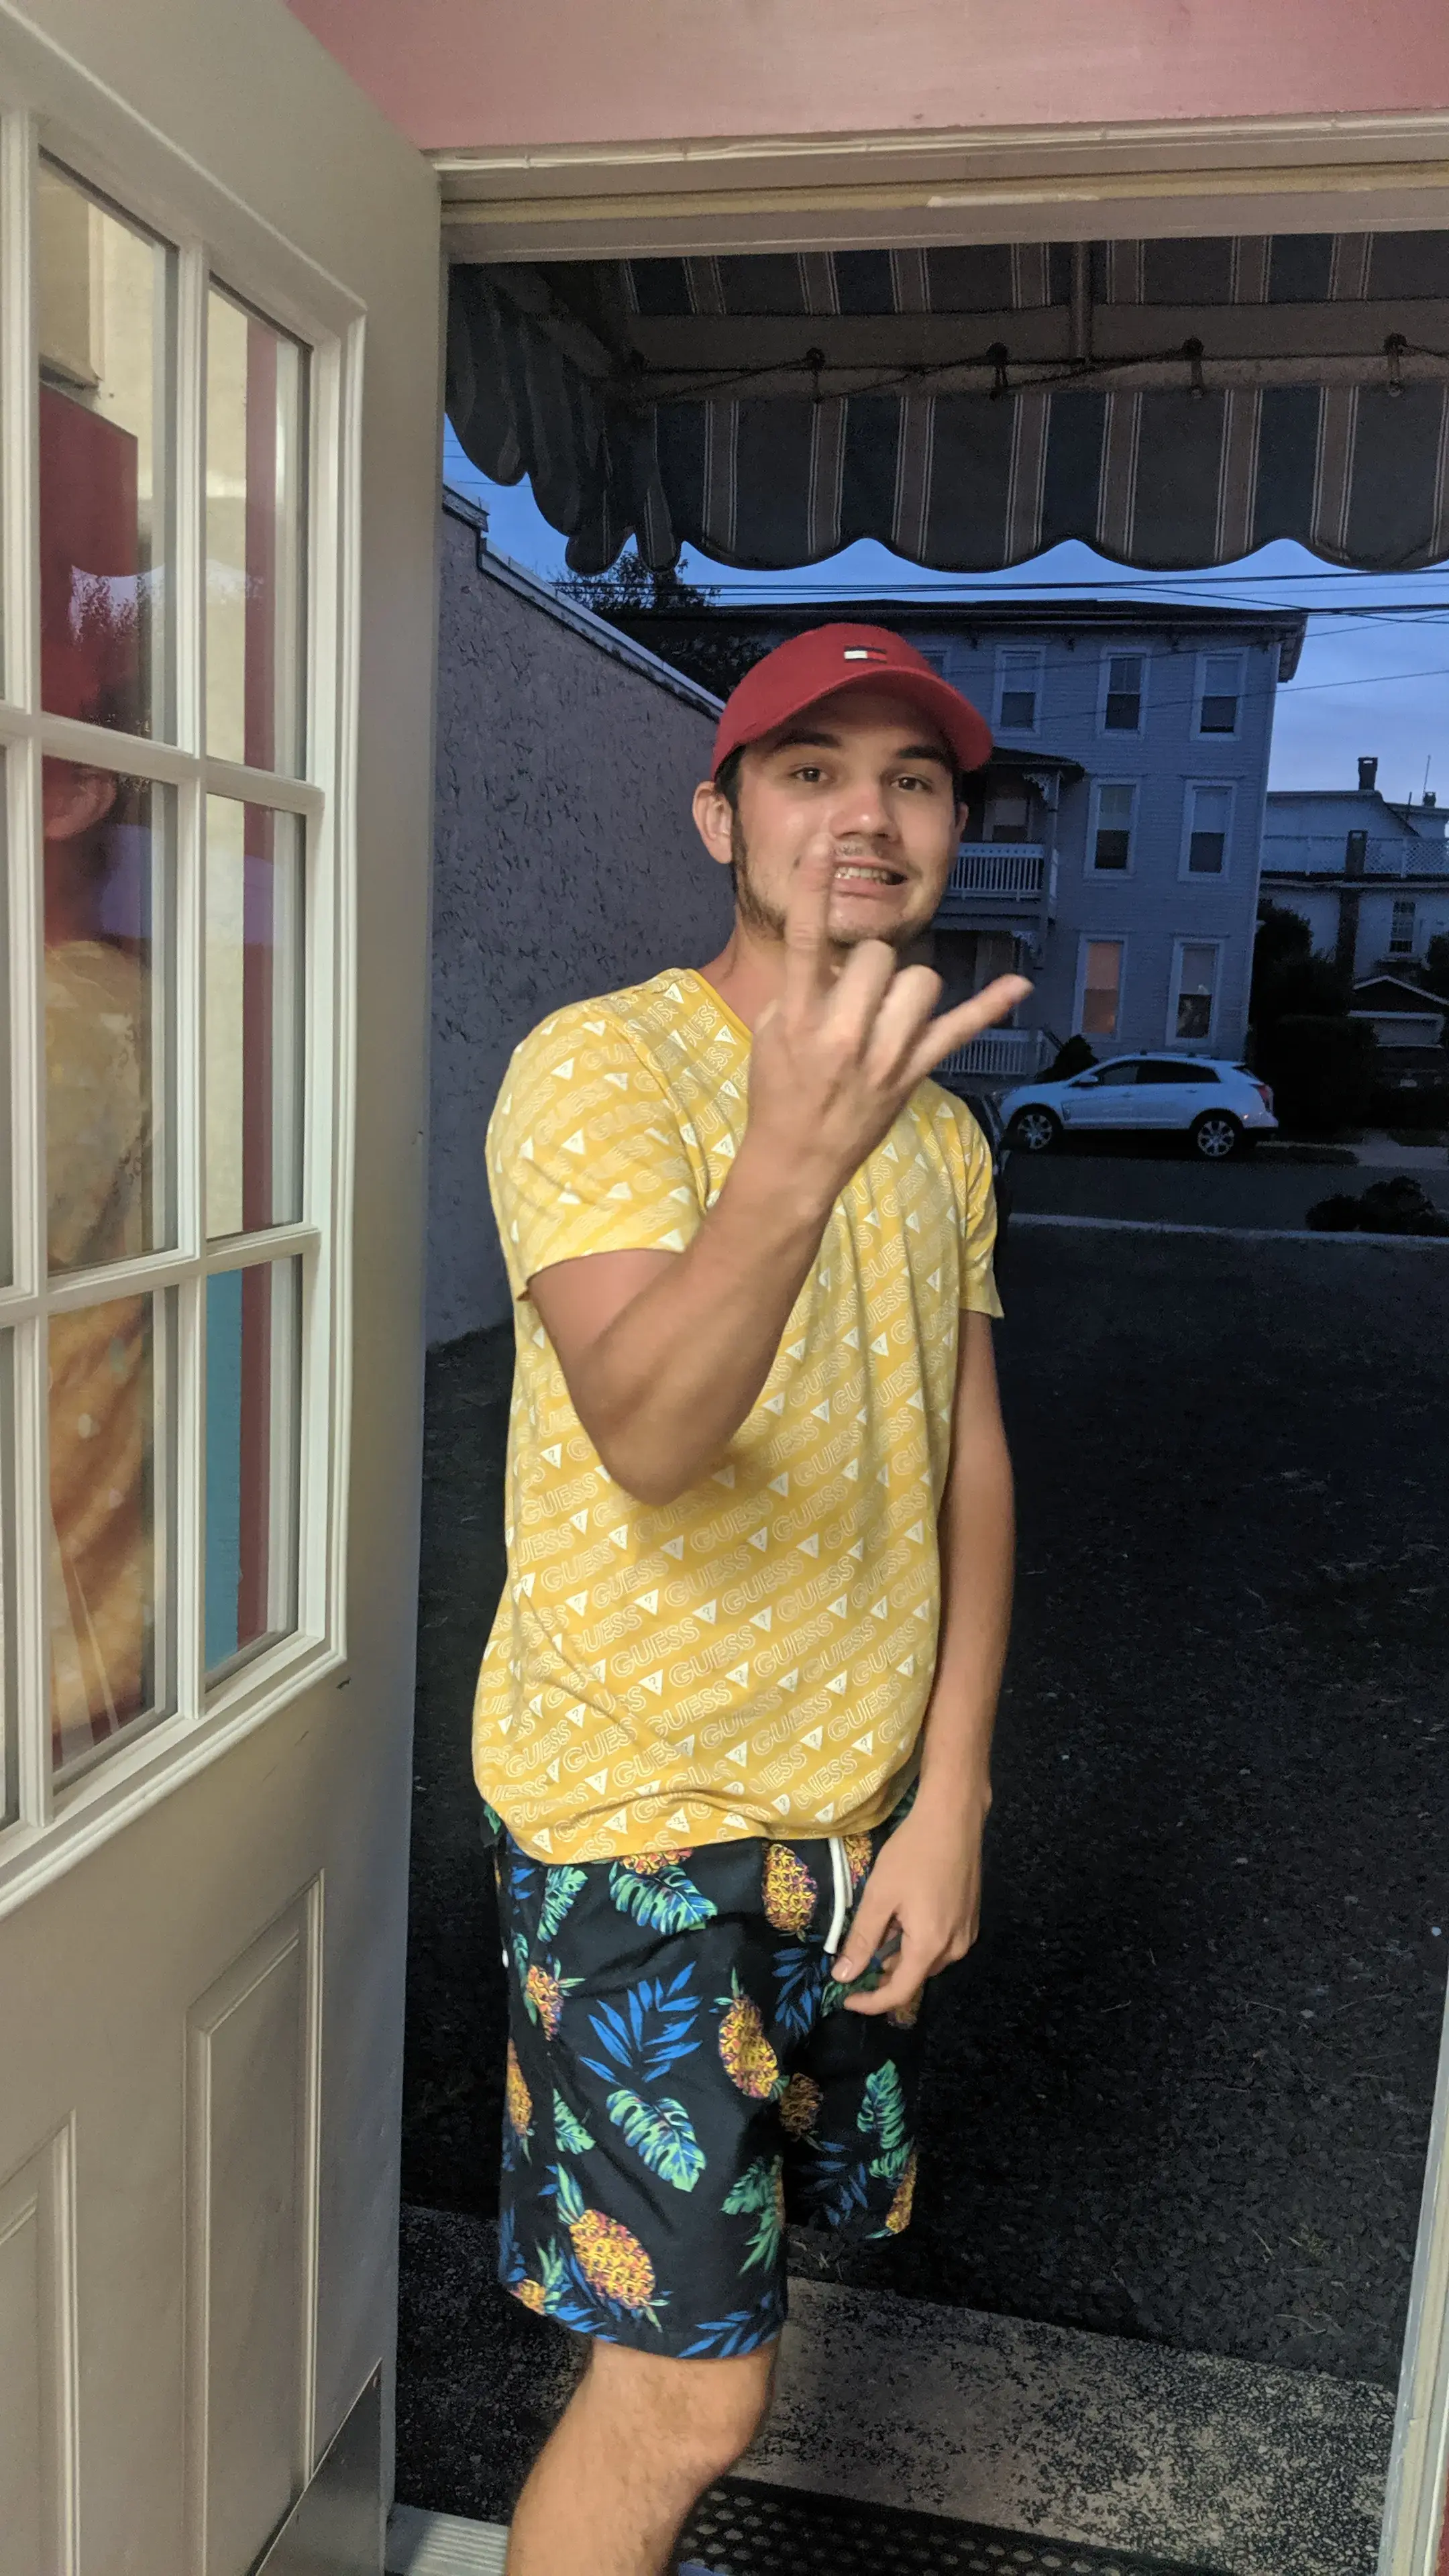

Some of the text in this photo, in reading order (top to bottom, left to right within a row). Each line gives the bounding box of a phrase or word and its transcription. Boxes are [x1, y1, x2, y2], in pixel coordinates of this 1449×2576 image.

[580, 1043, 641, 1070] GUE
[844, 1157, 892, 1212] GUSS
[865, 1277, 908, 1332] UESS
[788, 1344, 851, 1407] GUESS
[874, 1352, 920, 1407] UES
[793, 1421, 863, 1487] GUESS
[522, 1472, 598, 1525] GUESS
[690, 1491, 773, 1552] GUESS
[772, 1477, 848, 1542] GUESS
[517, 1523, 575, 1567] UESS
[541, 1538, 616, 1593] GUESS
[592, 1552, 669, 1608] GUESS
[665, 1545, 751, 1607] GUESS
[722, 1550, 804, 1615] GUESS
[777, 1556, 854, 1621] GUESS
[610, 1617, 700, 1678] GUESS
[669, 1625, 755, 1687] GUESS
[753, 1613, 833, 1676] GUESS
[803, 1616, 876, 1682] GUESS
[852, 1617, 917, 1686] GUESS
[645, 1680, 732, 1737] GUESS
[700, 1686, 783, 1749] GUESS
[752, 1690, 832, 1755] GUESS
[828, 1674, 901, 1741] GUESS
[506, 1719, 571, 1778] GUESS
[612, 1741, 681, 1787] GUES
[749, 1744, 807, 1794] UESS
[483, 1774, 548, 1805] UESS
[792, 1750, 857, 1809] GUESS
[566, 1828, 616, 1863] ESS
